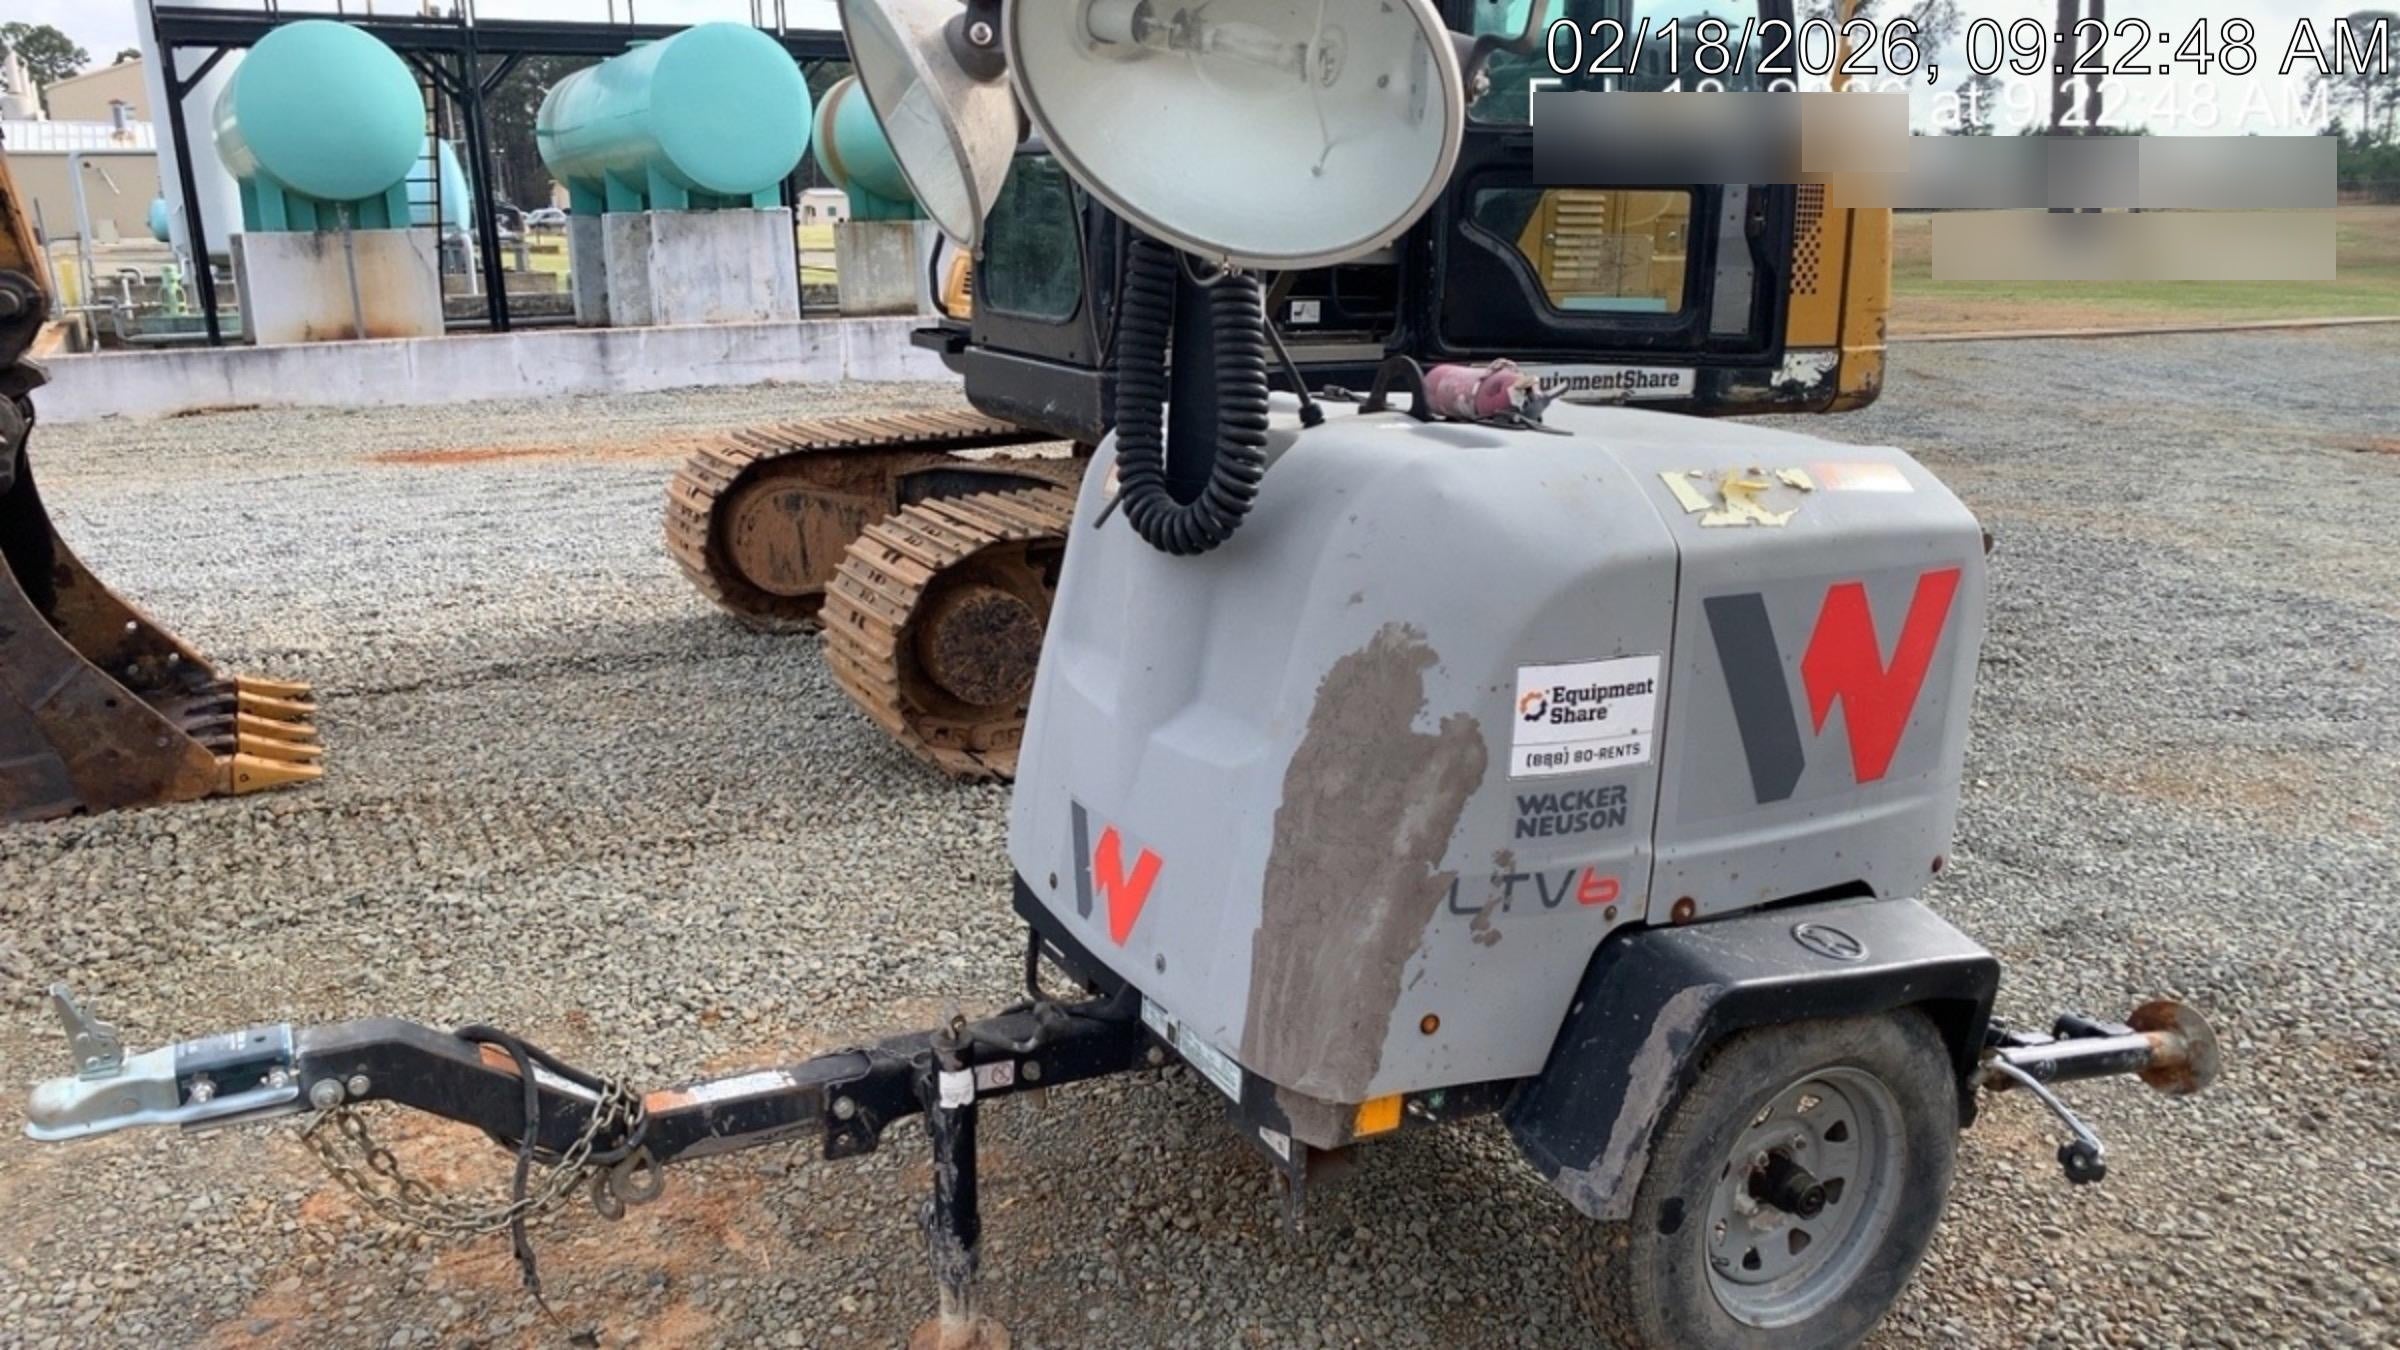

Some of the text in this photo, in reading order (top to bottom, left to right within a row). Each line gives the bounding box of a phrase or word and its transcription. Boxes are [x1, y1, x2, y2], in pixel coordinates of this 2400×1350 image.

[1552, 678, 1654, 706] Equipment
[1550, 706, 1608, 725] Share
[1526, 742, 1641, 768] (888) 80-RENTS
[1516, 785, 1627, 816] WACKER
[1515, 806, 1627, 839] NEUSON
